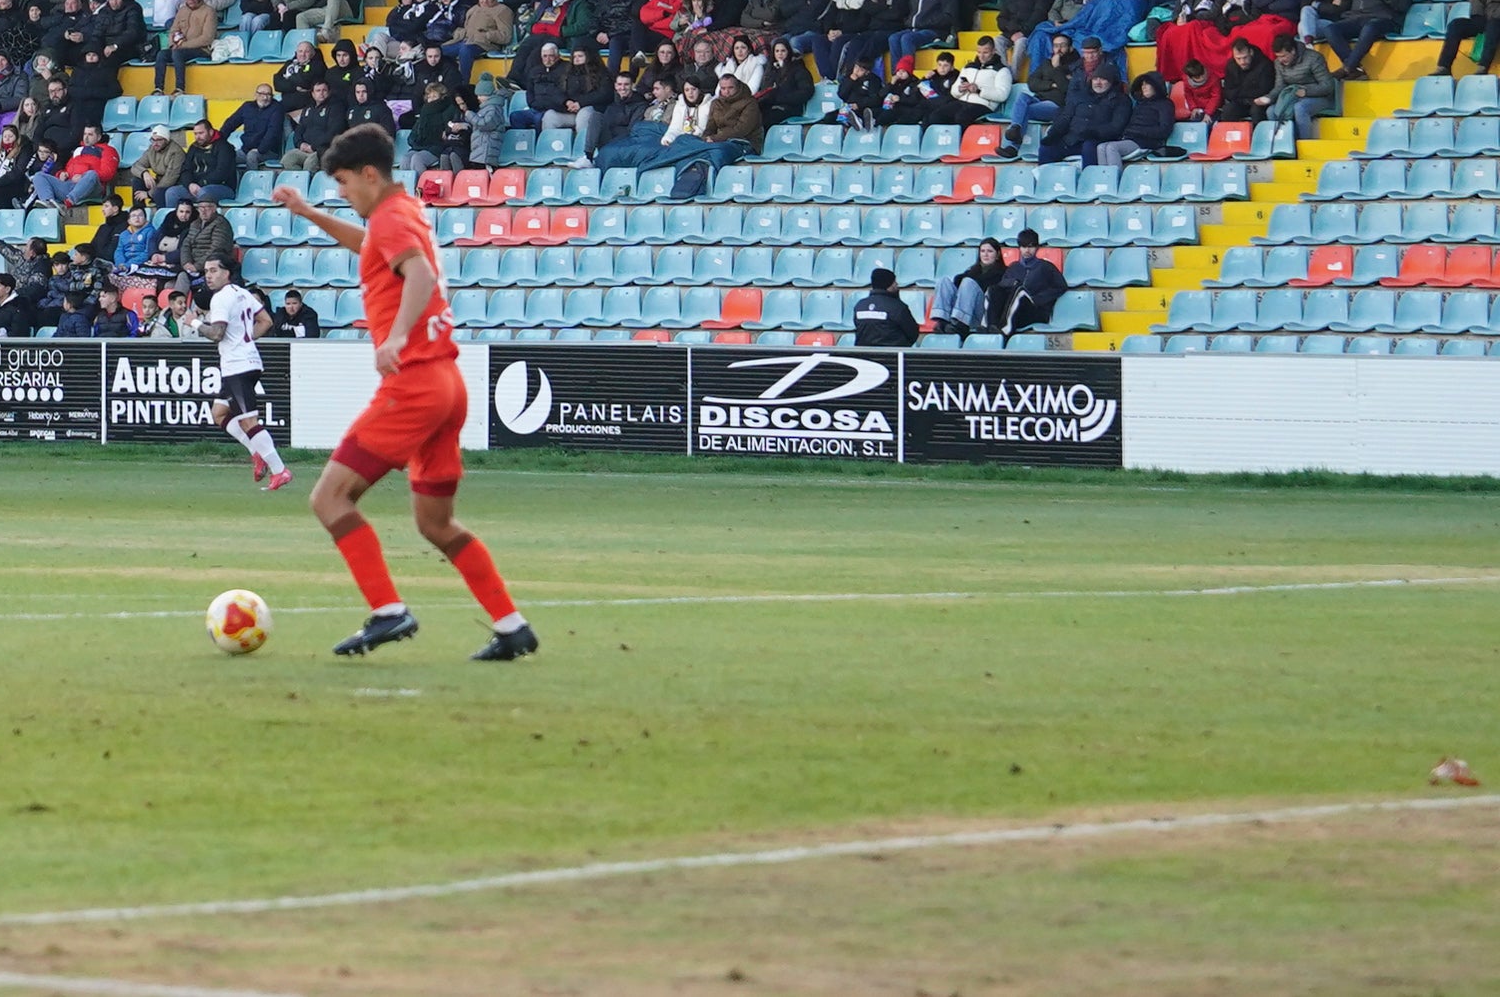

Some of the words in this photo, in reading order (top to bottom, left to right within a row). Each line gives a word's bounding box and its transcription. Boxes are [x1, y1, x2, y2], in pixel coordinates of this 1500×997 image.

[8, 349, 64, 371] grupo
[908, 379, 1094, 414] SANMÁXIMO
[560, 401, 682, 426] PANELAIS
[700, 405, 891, 433] DISCOSA
[545, 423, 621, 435] PRODUCCIONES
[965, 415, 1081, 442] TELECOM
[699, 435, 720, 451] DE
[723, 436, 858, 456] ALIMENTACION,
[862, 439, 893, 457] S.L.
